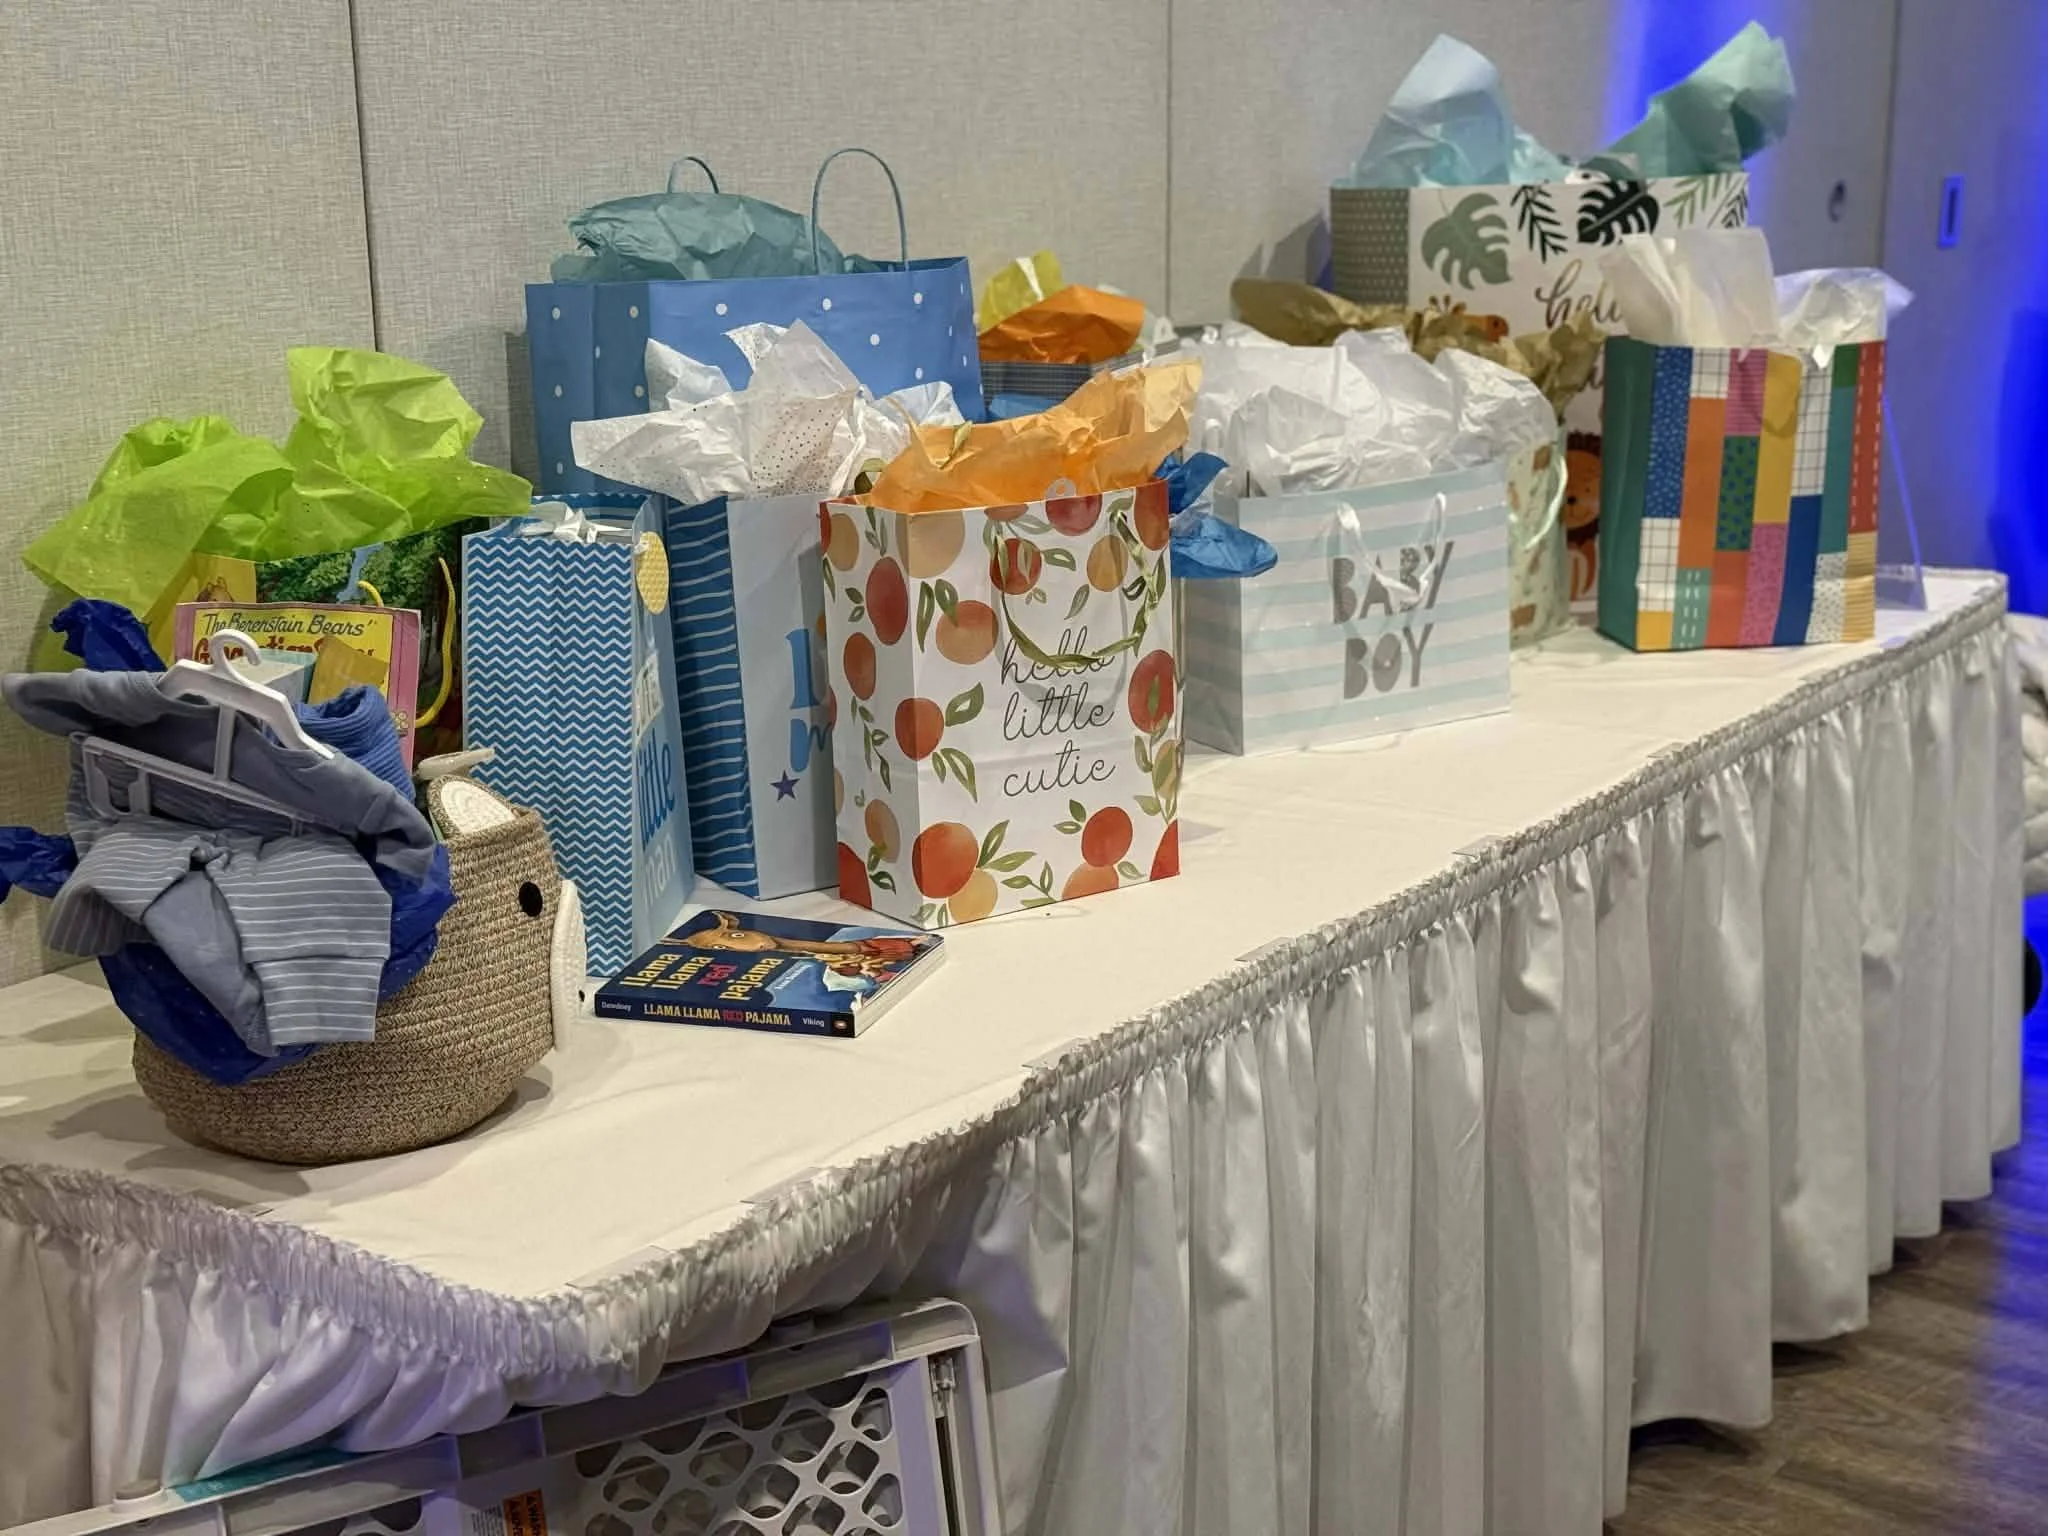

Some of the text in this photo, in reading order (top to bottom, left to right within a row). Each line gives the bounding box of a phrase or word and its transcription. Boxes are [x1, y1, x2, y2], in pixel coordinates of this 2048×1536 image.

[1333, 541, 1455, 624] BABY
[203, 613, 227, 635] The
[229, 613, 303, 634] Berenstain
[1343, 622, 1435, 700] BOY
[1002, 681, 1115, 741] little
[1003, 739, 1117, 797] cutie
[636, 727, 675, 854] little
[619, 953, 684, 987] llama
[650, 956, 715, 990] llama
[696, 964, 738, 986] red
[718, 958, 785, 1001] pajama
[643, 1003, 681, 1017] LLAMA
[683, 1006, 721, 1020] LLAMA
[745, 1011, 792, 1026] PAJAMA
[802, 1017, 825, 1028] Viking
